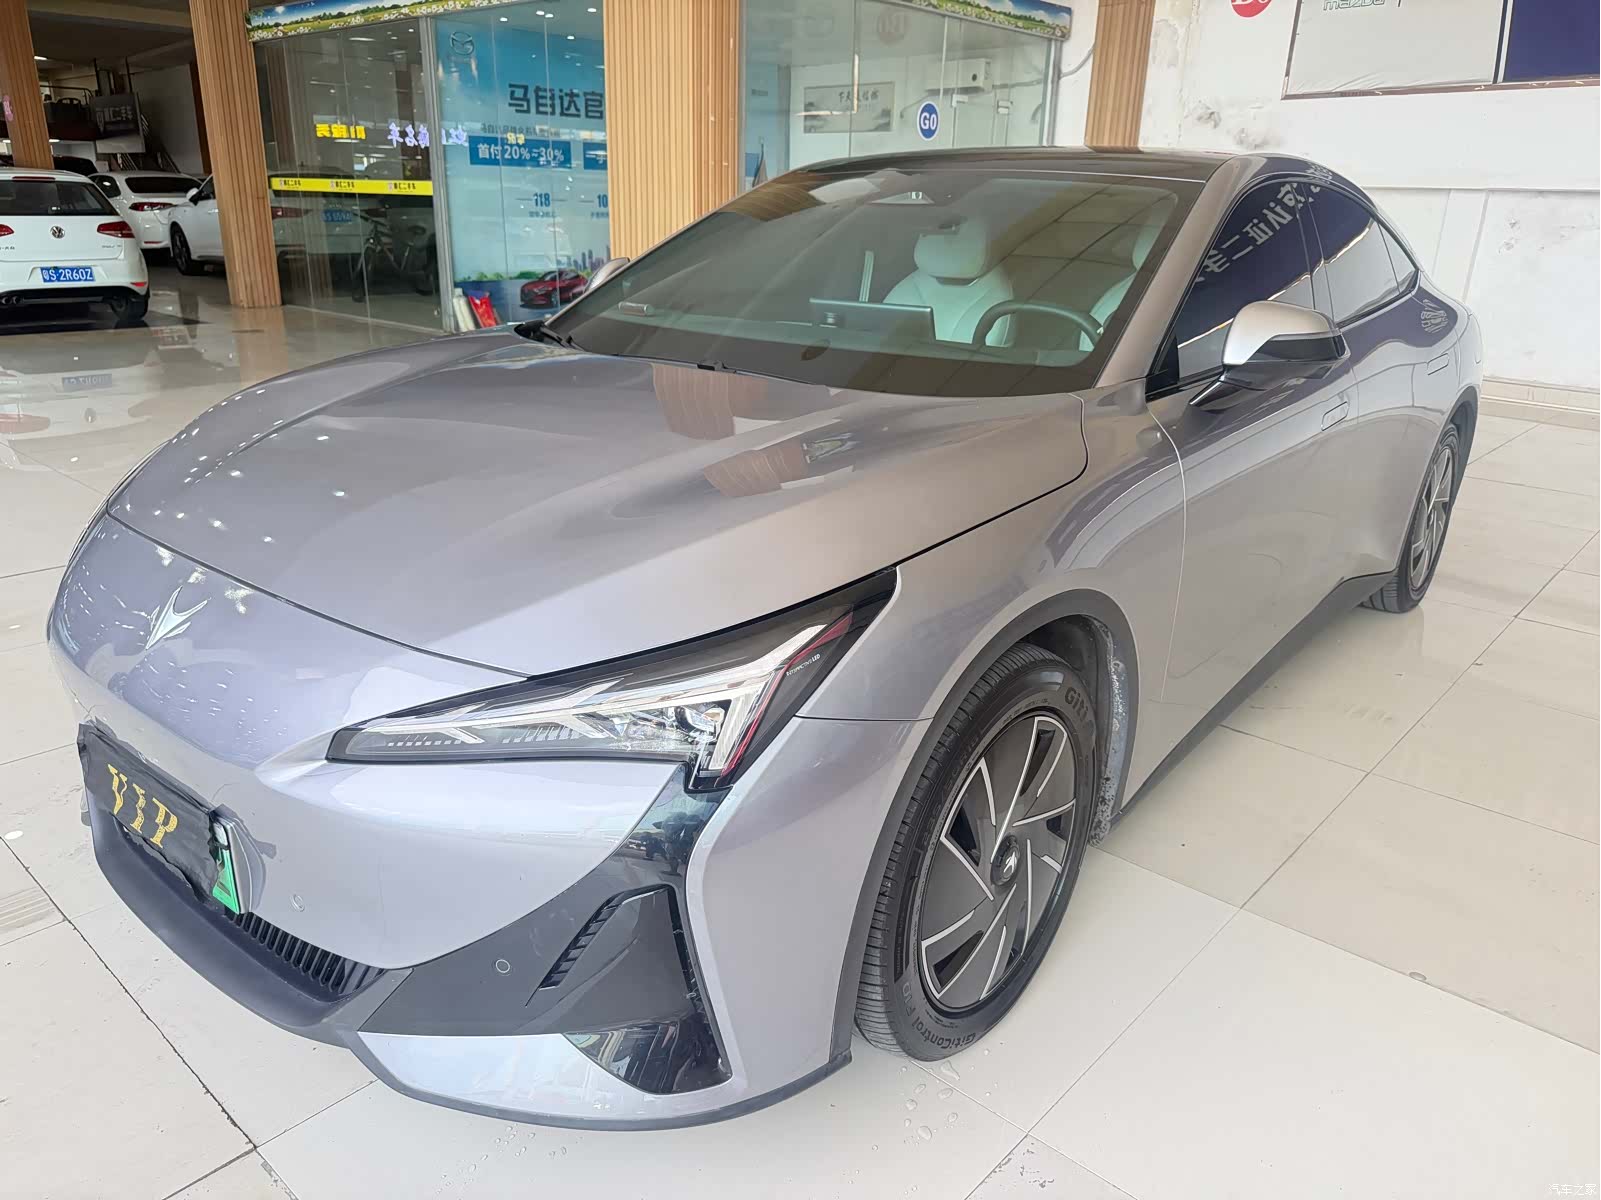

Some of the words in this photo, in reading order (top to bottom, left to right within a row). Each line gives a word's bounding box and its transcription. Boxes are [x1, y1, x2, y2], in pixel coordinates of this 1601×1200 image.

[508, 83, 604, 120] 马自达官
[1064, 686, 1089, 722] Giti
[106, 763, 180, 849] VIP
[911, 1015, 977, 1049] GitiControl
